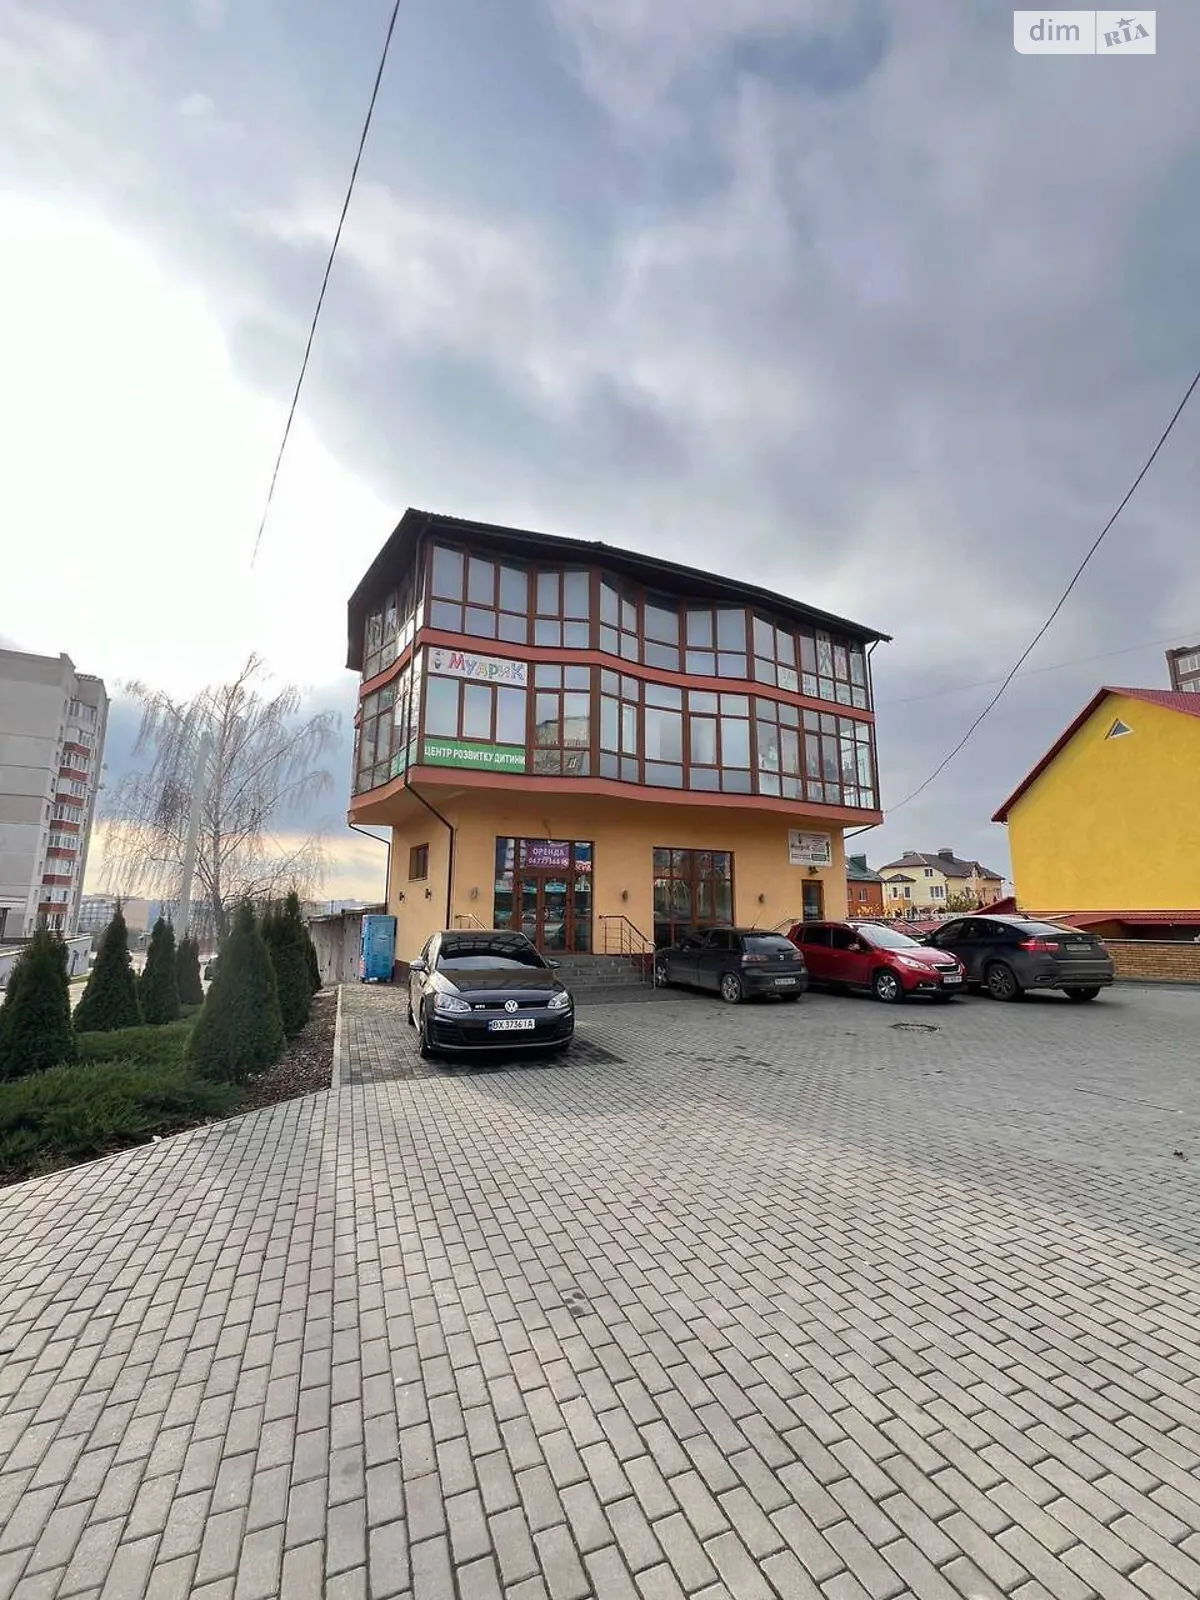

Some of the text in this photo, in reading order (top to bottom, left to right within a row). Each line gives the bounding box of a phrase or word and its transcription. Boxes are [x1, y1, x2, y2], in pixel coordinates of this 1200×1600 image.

[424, 746, 452, 757] ЦЕНТР
[453, 749, 493, 762] РОЗВИТКУ
[533, 848, 566, 857] ОРЕНДА
